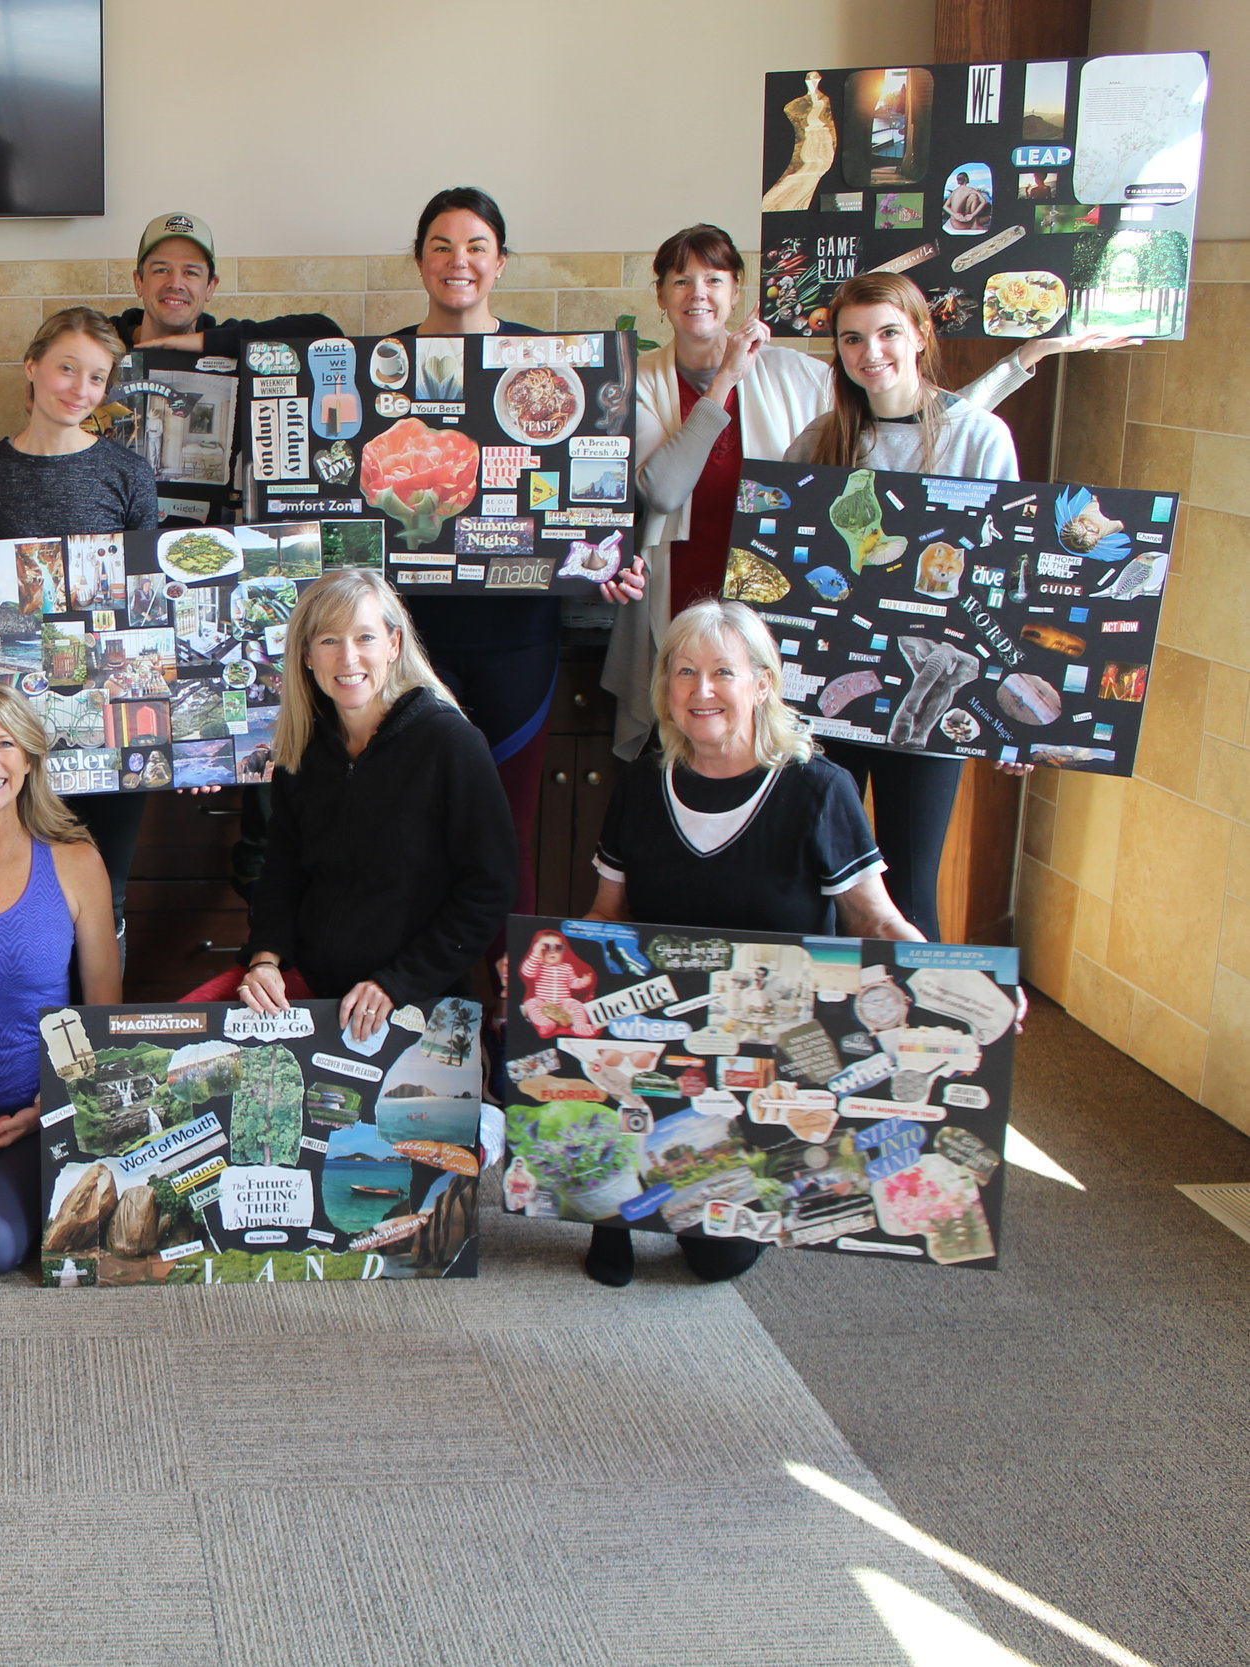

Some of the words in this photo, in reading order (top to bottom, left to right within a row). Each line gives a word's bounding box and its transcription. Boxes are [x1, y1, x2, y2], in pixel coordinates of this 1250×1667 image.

[969, 67, 996, 124] WE
[1015, 149, 1072, 166] LEAP
[816, 236, 857, 257] GAME
[817, 258, 855, 278] PLAN
[314, 343, 347, 352] what
[488, 338, 546, 365] Let's
[548, 337, 594, 364] Eat!
[249, 352, 294, 372] epic
[260, 378, 293, 387] WEEKNIGHT
[322, 372, 347, 382] love
[123, 382, 171, 397] ENERGIZE
[260, 387, 287, 395] WINNERS
[379, 395, 410, 413] Be
[415, 405, 437, 413] Your
[440, 405, 461, 413] Best
[286, 401, 304, 430] off
[255, 403, 275, 448] duty
[523, 420, 558, 432] FEAST?
[588, 439, 619, 447] Breath
[285, 431, 304, 475] duty
[484, 447, 531, 457] HERE
[583, 448, 609, 457] Fresh
[612, 448, 628, 457] Air
[261, 451, 274, 477] on
[321, 458, 355, 481] LOVE
[483, 457, 539, 467] COMES
[485, 467, 518, 478] THE
[483, 478, 513, 487] SUN
[173, 503, 205, 515] Giggles
[269, 501, 316, 513] Comfort
[318, 501, 360, 512] Zone
[460, 518, 528, 532] Summer
[467, 533, 519, 549] Nights
[1137, 534, 1162, 542] Change
[751, 538, 778, 559] ENGAGE
[432, 554, 450, 563] happy
[1039, 561, 1049, 569] IN
[1051, 562, 1069, 571] THE
[1040, 554, 1052, 562] AT
[1054, 556, 1081, 565] HOME
[490, 560, 551, 588] magic
[972, 568, 1005, 586] dive
[1037, 568, 1075, 579] WORLD
[990, 589, 1002, 604] in
[1040, 584, 1082, 596] GUIDE
[879, 599, 901, 611] MOVE
[904, 603, 947, 615] FORWARD
[759, 612, 816, 630] Awakening
[1102, 622, 1118, 632] ACT
[1119, 621, 1139, 631] NOW
[944, 628, 965, 639] SHINE
[961, 594, 1027, 667] WORDS
[849, 653, 881, 663] Protect
[783, 672, 825, 684] GREATEST
[968, 696, 993, 721] Marine
[991, 718, 1014, 741] Magic
[822, 728, 851, 738] BEING
[856, 734, 883, 743] TOLD
[956, 746, 986, 756] EXPLORE
[592, 1000, 626, 1026] the
[627, 984, 670, 1013] life
[110, 1018, 204, 1031] IMAGINATION.
[612, 1018, 687, 1037] where
[315, 1056, 341, 1068] DISCOVER
[340, 1062, 355, 1073] YOUR
[354, 1066, 381, 1080] PLEASURE
[830, 1057, 897, 1093] what
[541, 1089, 601, 1100] FLORIDA
[856, 1117, 899, 1148] STEP
[119, 1149, 158, 1172] Word
[157, 1137, 172, 1152] of
[171, 1116, 218, 1144] Mouth
[302, 1138, 328, 1151] TIMELESS
[879, 1126, 926, 1158] INTO
[867, 1147, 919, 1180] SAND
[171, 1158, 225, 1190] balance
[190, 1186, 218, 1206] love
[236, 1190, 298, 1203] GETTING
[244, 1202, 291, 1214] THERE
